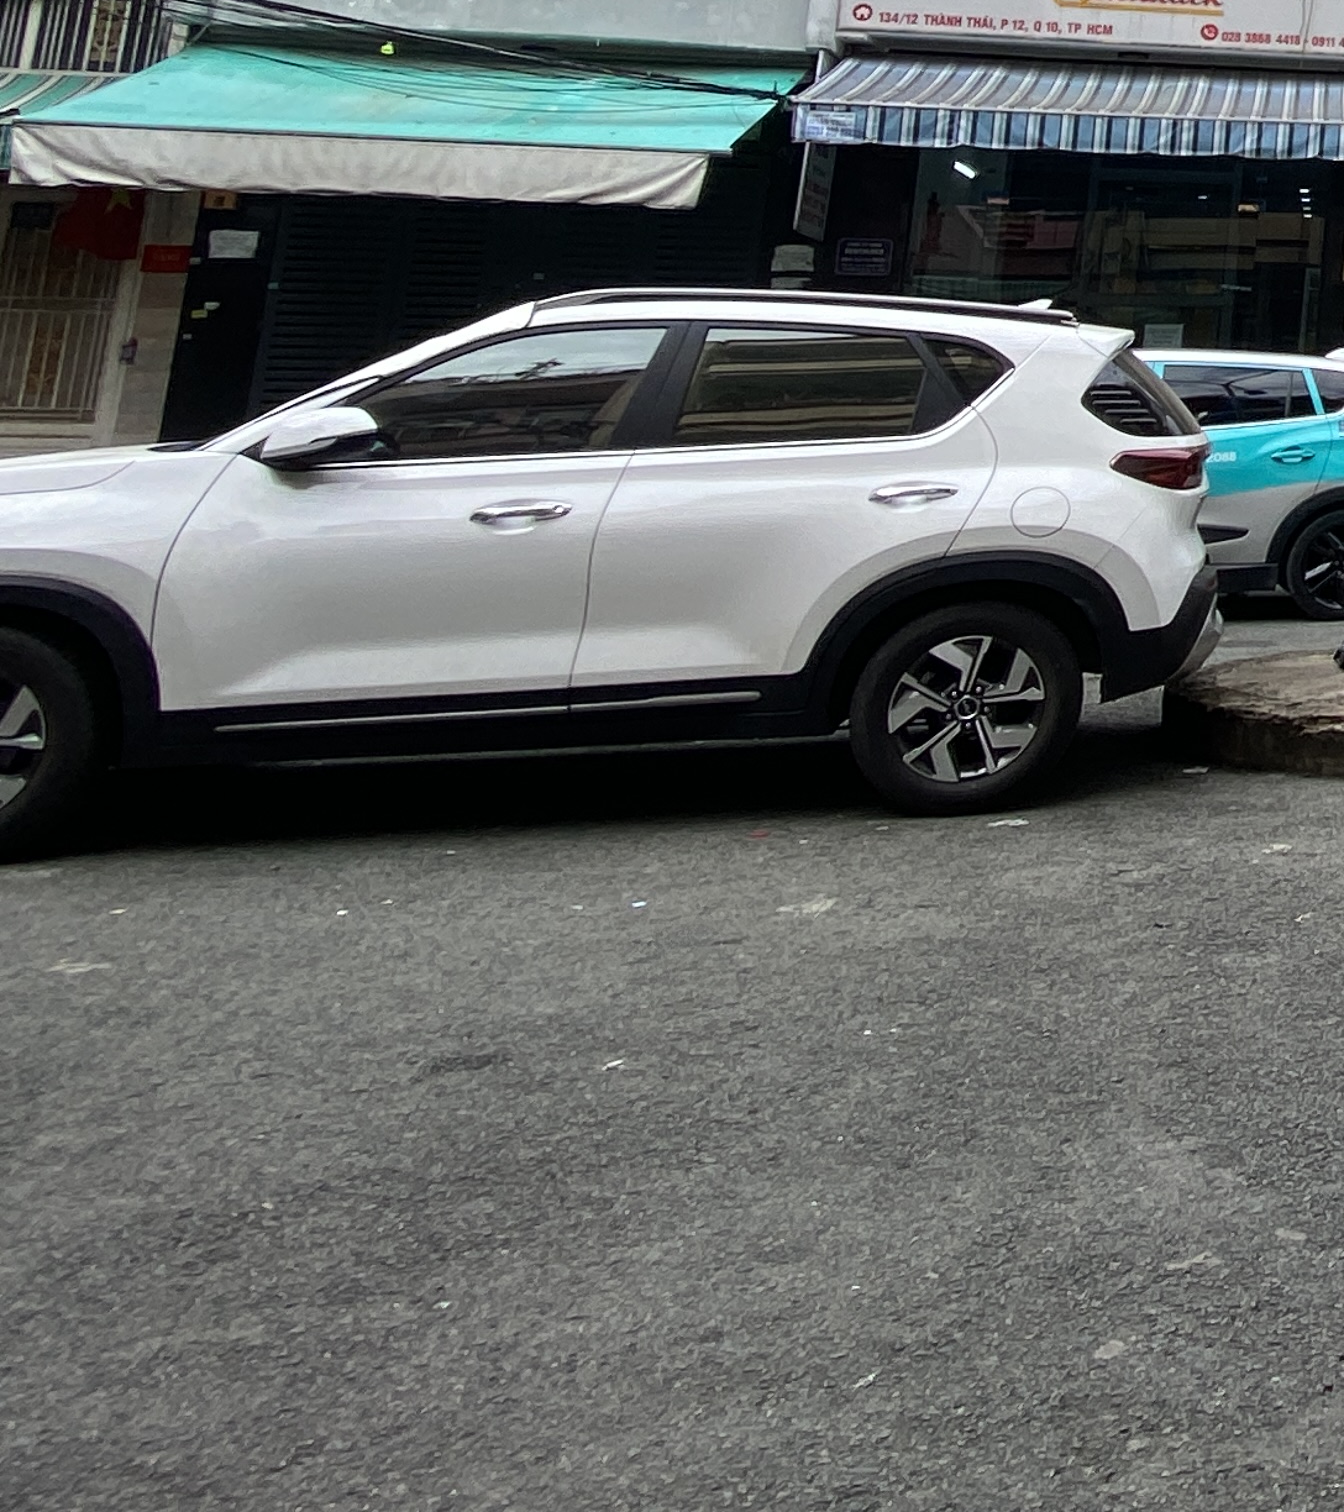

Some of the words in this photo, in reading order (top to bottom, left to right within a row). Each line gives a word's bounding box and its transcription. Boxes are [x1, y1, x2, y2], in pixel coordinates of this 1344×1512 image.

[879, 12, 918, 26] 134/12
[924, 13, 963, 27] THÀNH
[1001, 20, 1008, 30] P
[1068, 23, 1083, 34] TP
[1087, 24, 1114, 35] HCM
